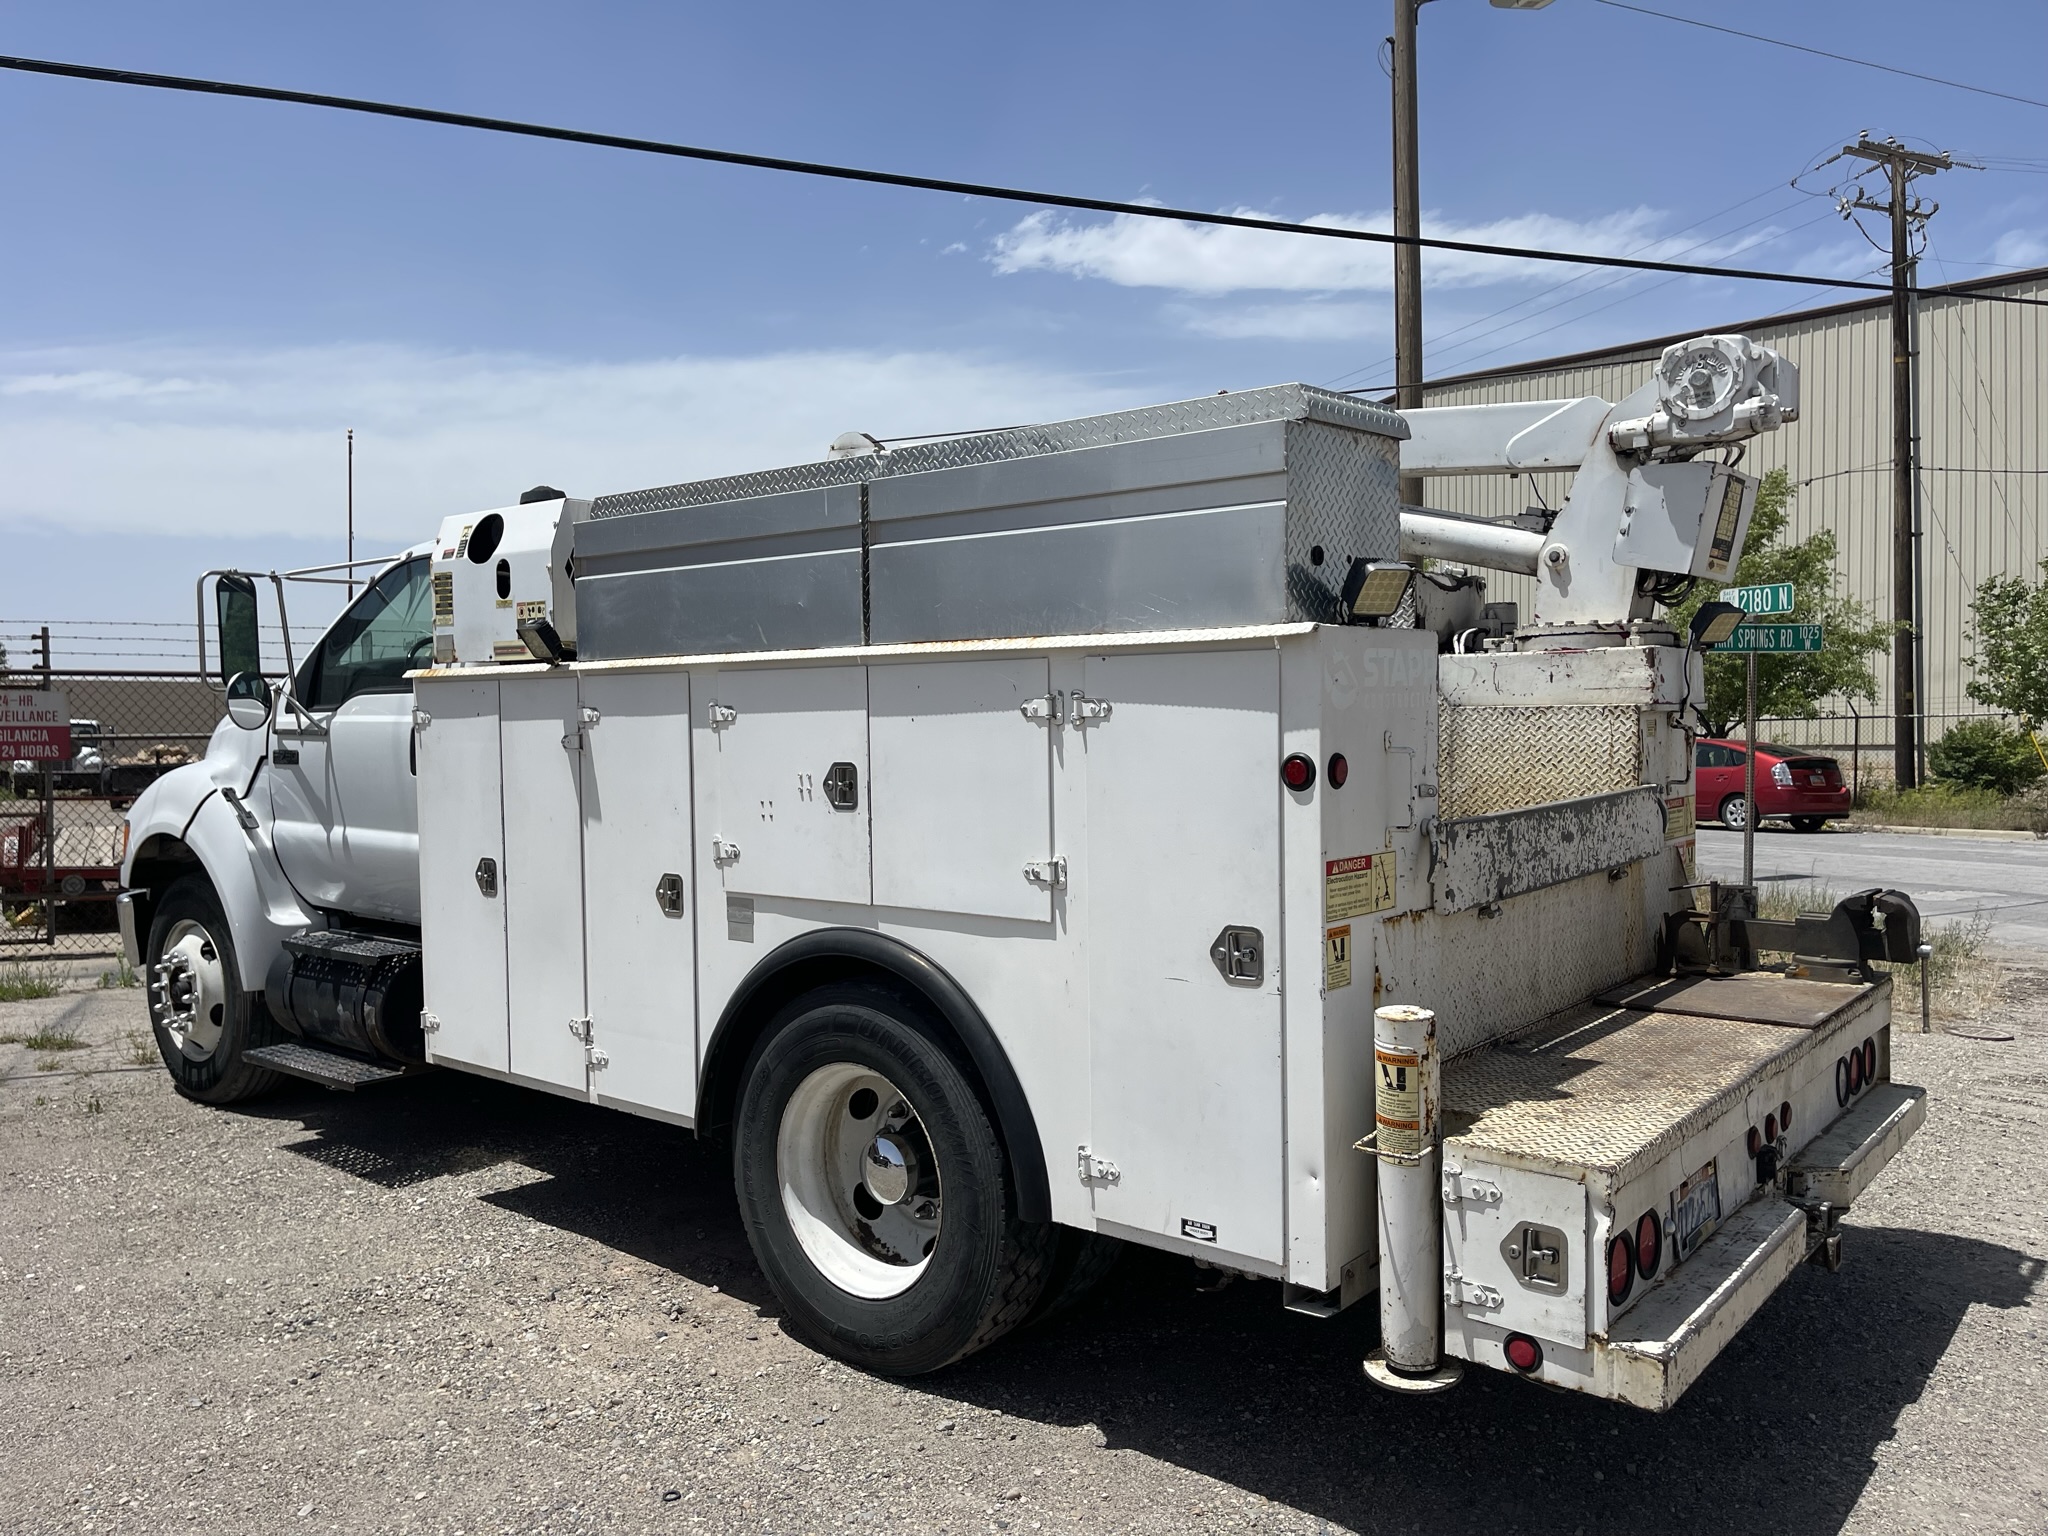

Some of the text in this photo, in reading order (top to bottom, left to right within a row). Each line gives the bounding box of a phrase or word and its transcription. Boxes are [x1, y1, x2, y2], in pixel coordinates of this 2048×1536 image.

[1739, 586, 1791, 612] 2180 N.
[1738, 628, 1775, 649] SPRINGS
[1780, 629, 1795, 648] RD.
[1799, 626, 1819, 639] 1025
[1804, 639, 1814, 651] W.
[2, 745, 59, 757] 24 HORAS
[1339, 858, 1366, 872] DANGER
[1382, 1055, 1415, 1065] WARNING
[1383, 1118, 1413, 1129] WARNING
